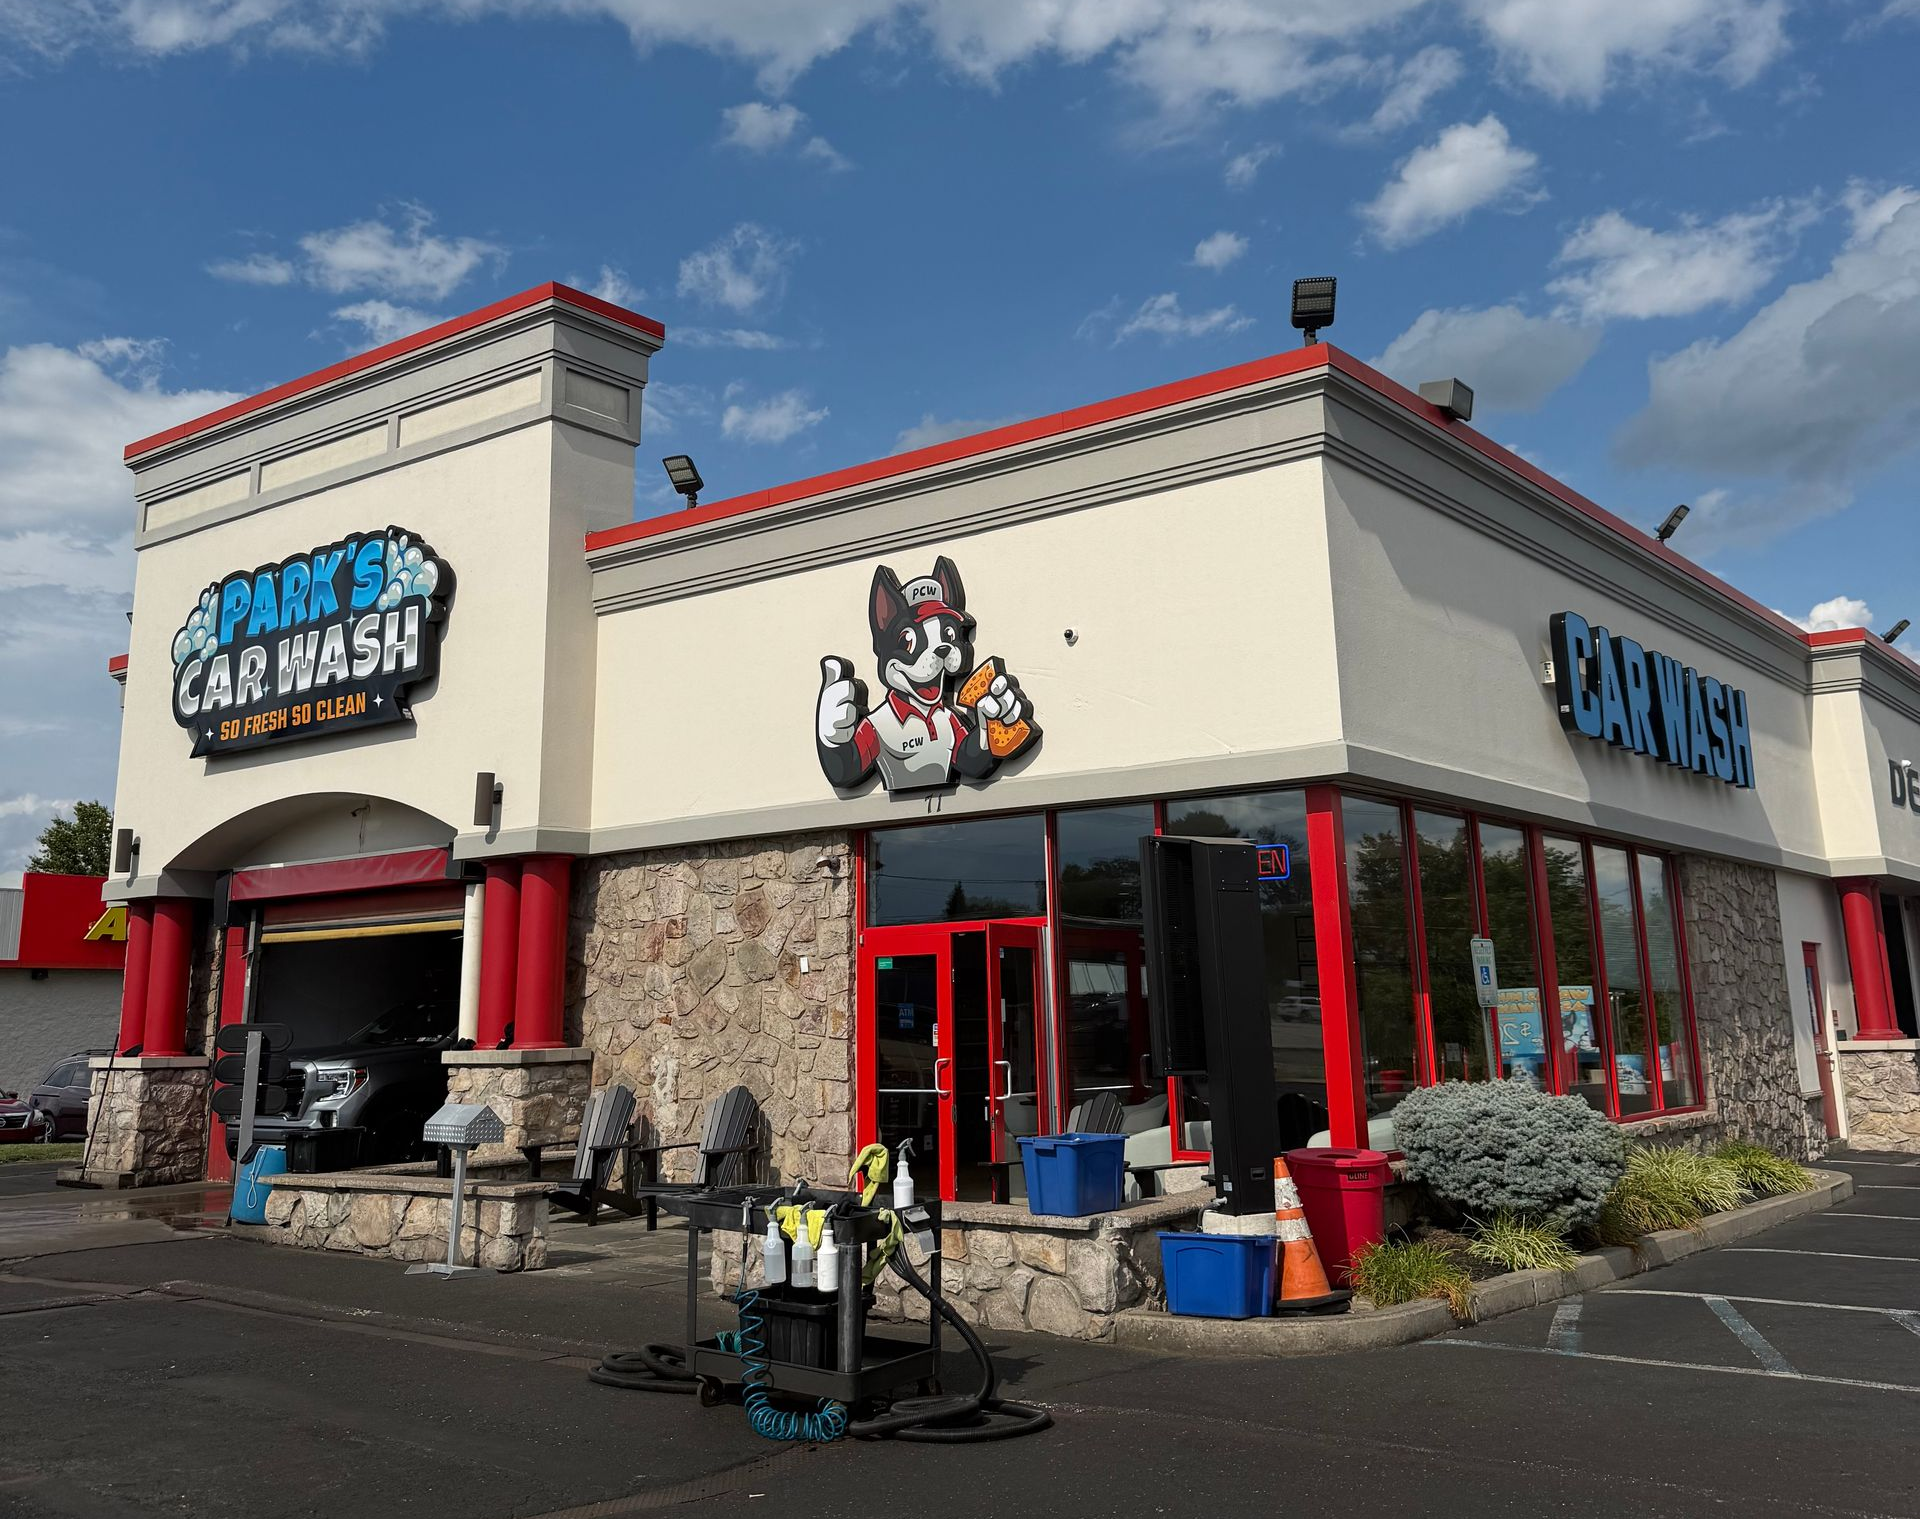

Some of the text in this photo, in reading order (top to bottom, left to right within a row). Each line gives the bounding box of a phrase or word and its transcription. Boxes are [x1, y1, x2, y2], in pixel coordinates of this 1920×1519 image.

[218, 539, 386, 647] PARK'S
[911, 584, 938, 600] PCW
[179, 605, 420, 718] CAR WASH
[220, 691, 367, 742] SO FRESH SO CLEAN
[1562, 611, 1756, 790] CAR WASH
[902, 736, 925, 752] PCW
[898, 1008, 914, 1017] ATM
